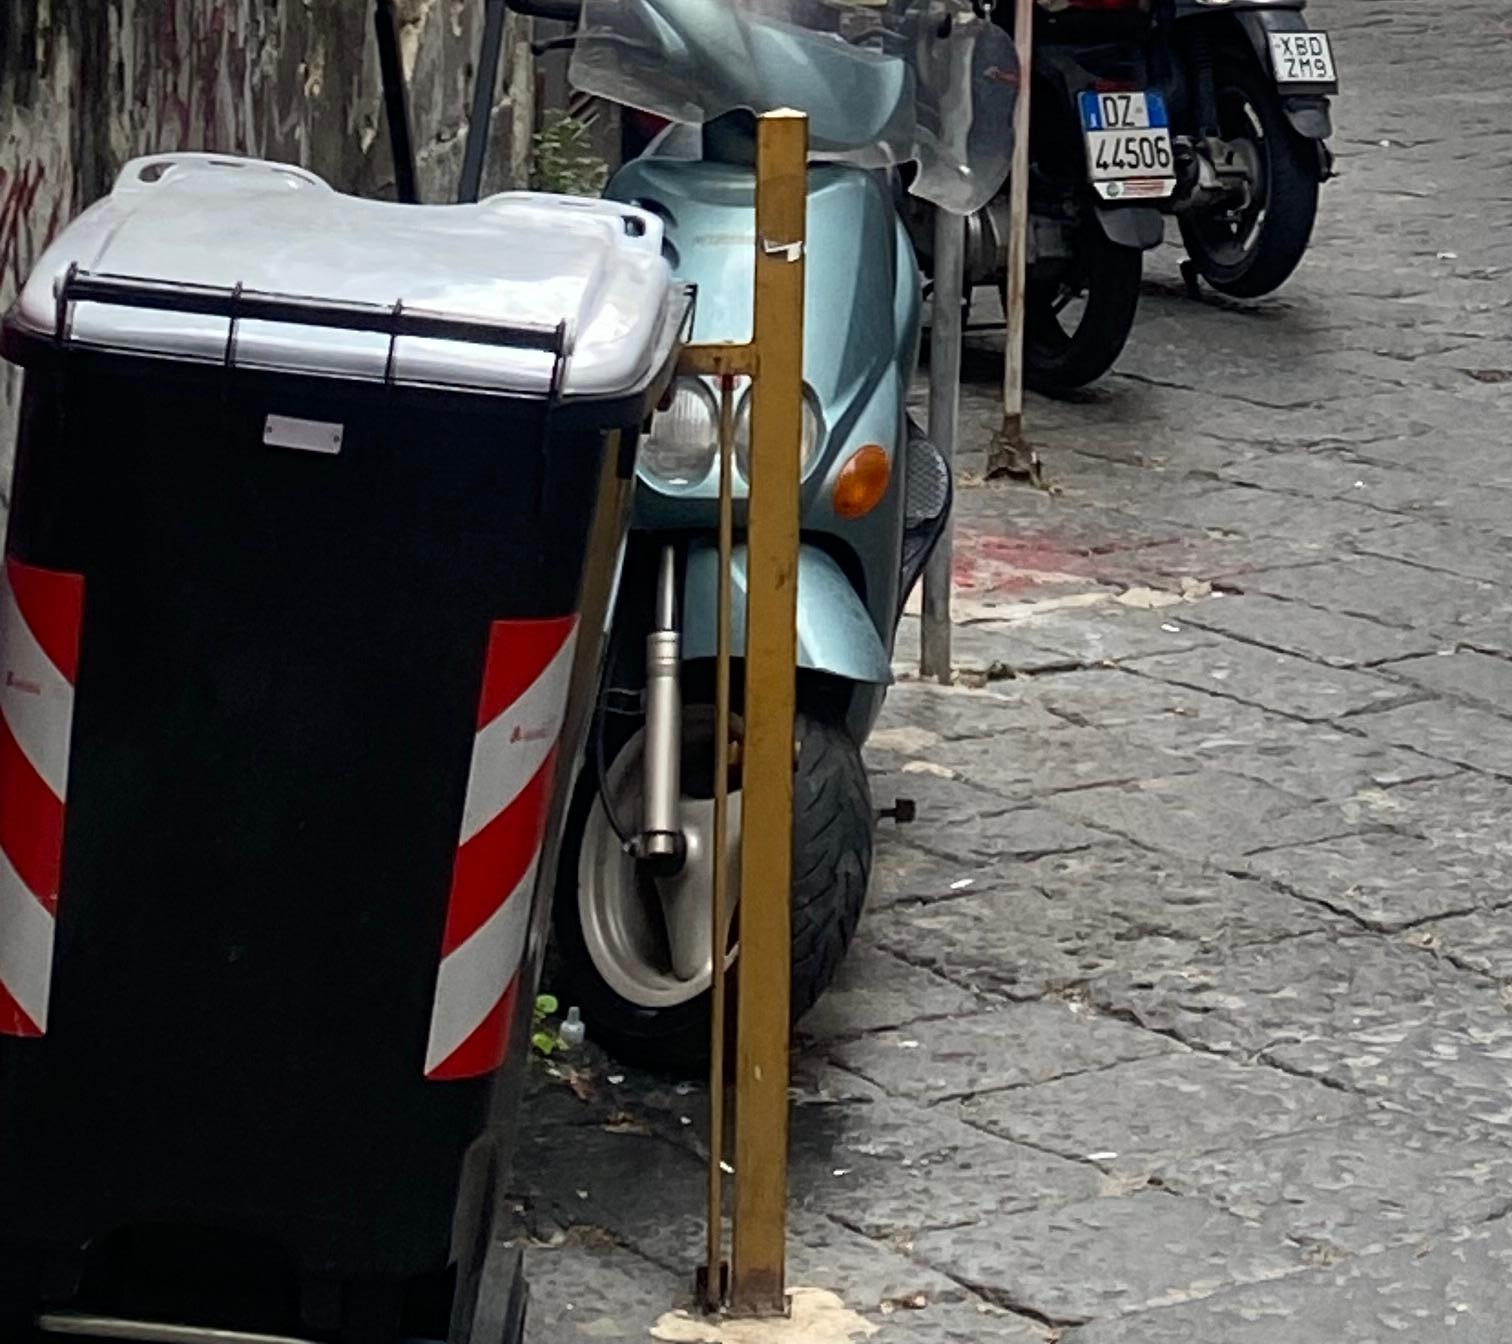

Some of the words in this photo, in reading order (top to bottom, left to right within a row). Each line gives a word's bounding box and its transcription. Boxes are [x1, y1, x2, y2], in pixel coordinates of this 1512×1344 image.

[1281, 37, 1323, 56] XBD
[1285, 60, 1327, 79] ZM9
[1102, 95, 1136, 126] DZ
[1095, 137, 1171, 171] 44506
